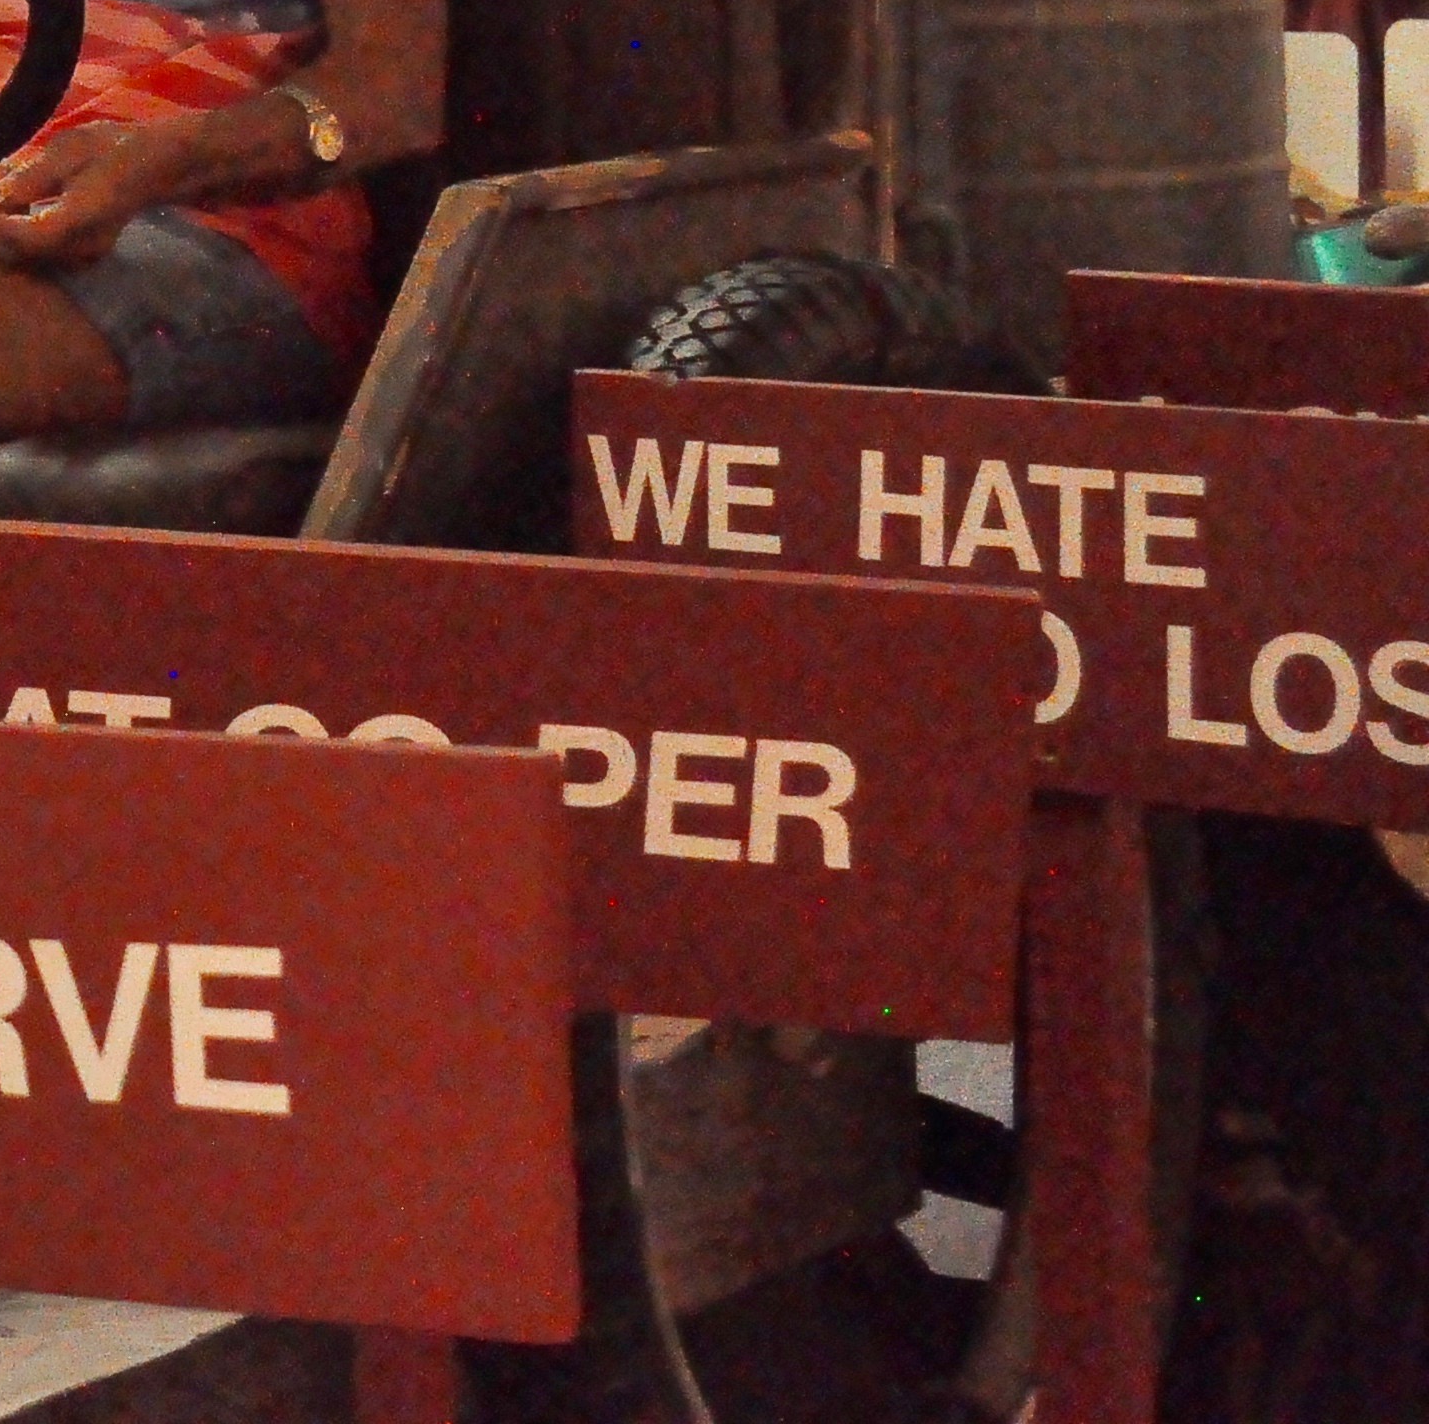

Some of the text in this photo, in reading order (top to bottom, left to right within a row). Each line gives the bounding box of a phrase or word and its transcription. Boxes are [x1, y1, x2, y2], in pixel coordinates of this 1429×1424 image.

[587, 434, 1207, 589] WE HATE
[538, 722, 857, 871] PER
